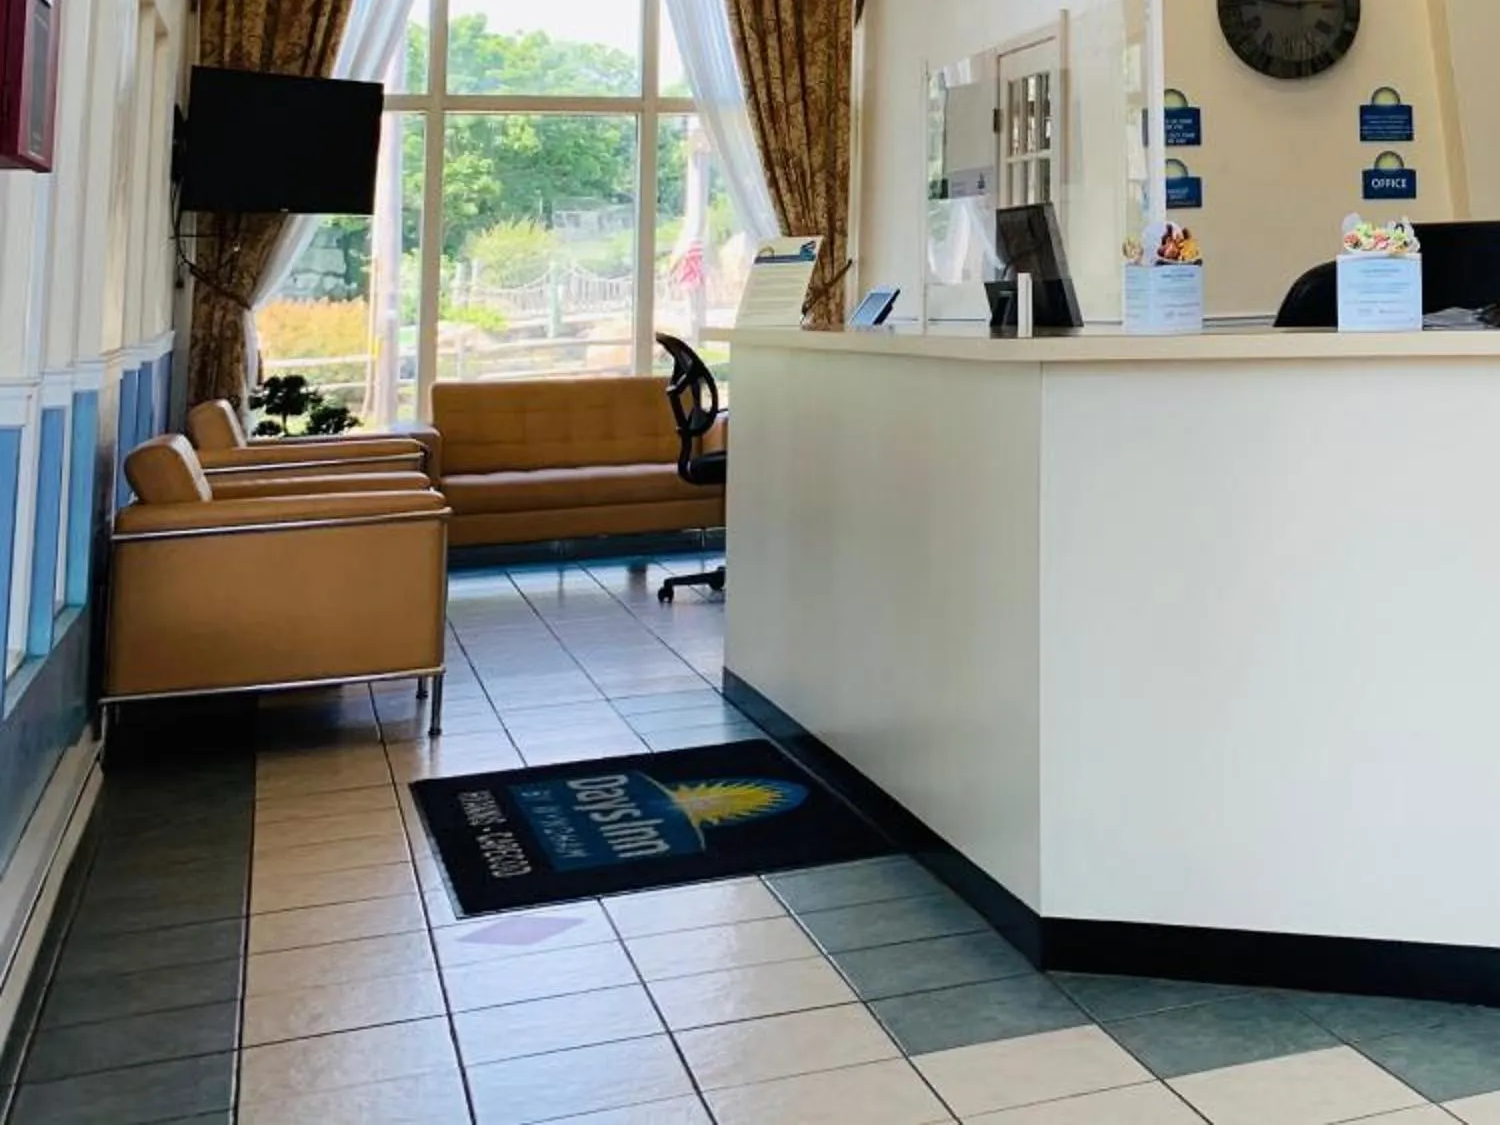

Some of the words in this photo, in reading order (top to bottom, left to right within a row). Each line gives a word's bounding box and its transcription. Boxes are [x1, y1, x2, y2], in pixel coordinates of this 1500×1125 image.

[1371, 177, 1408, 190] OFFICE
[566, 774, 643, 823] Days
[598, 818, 671, 858] Inn
